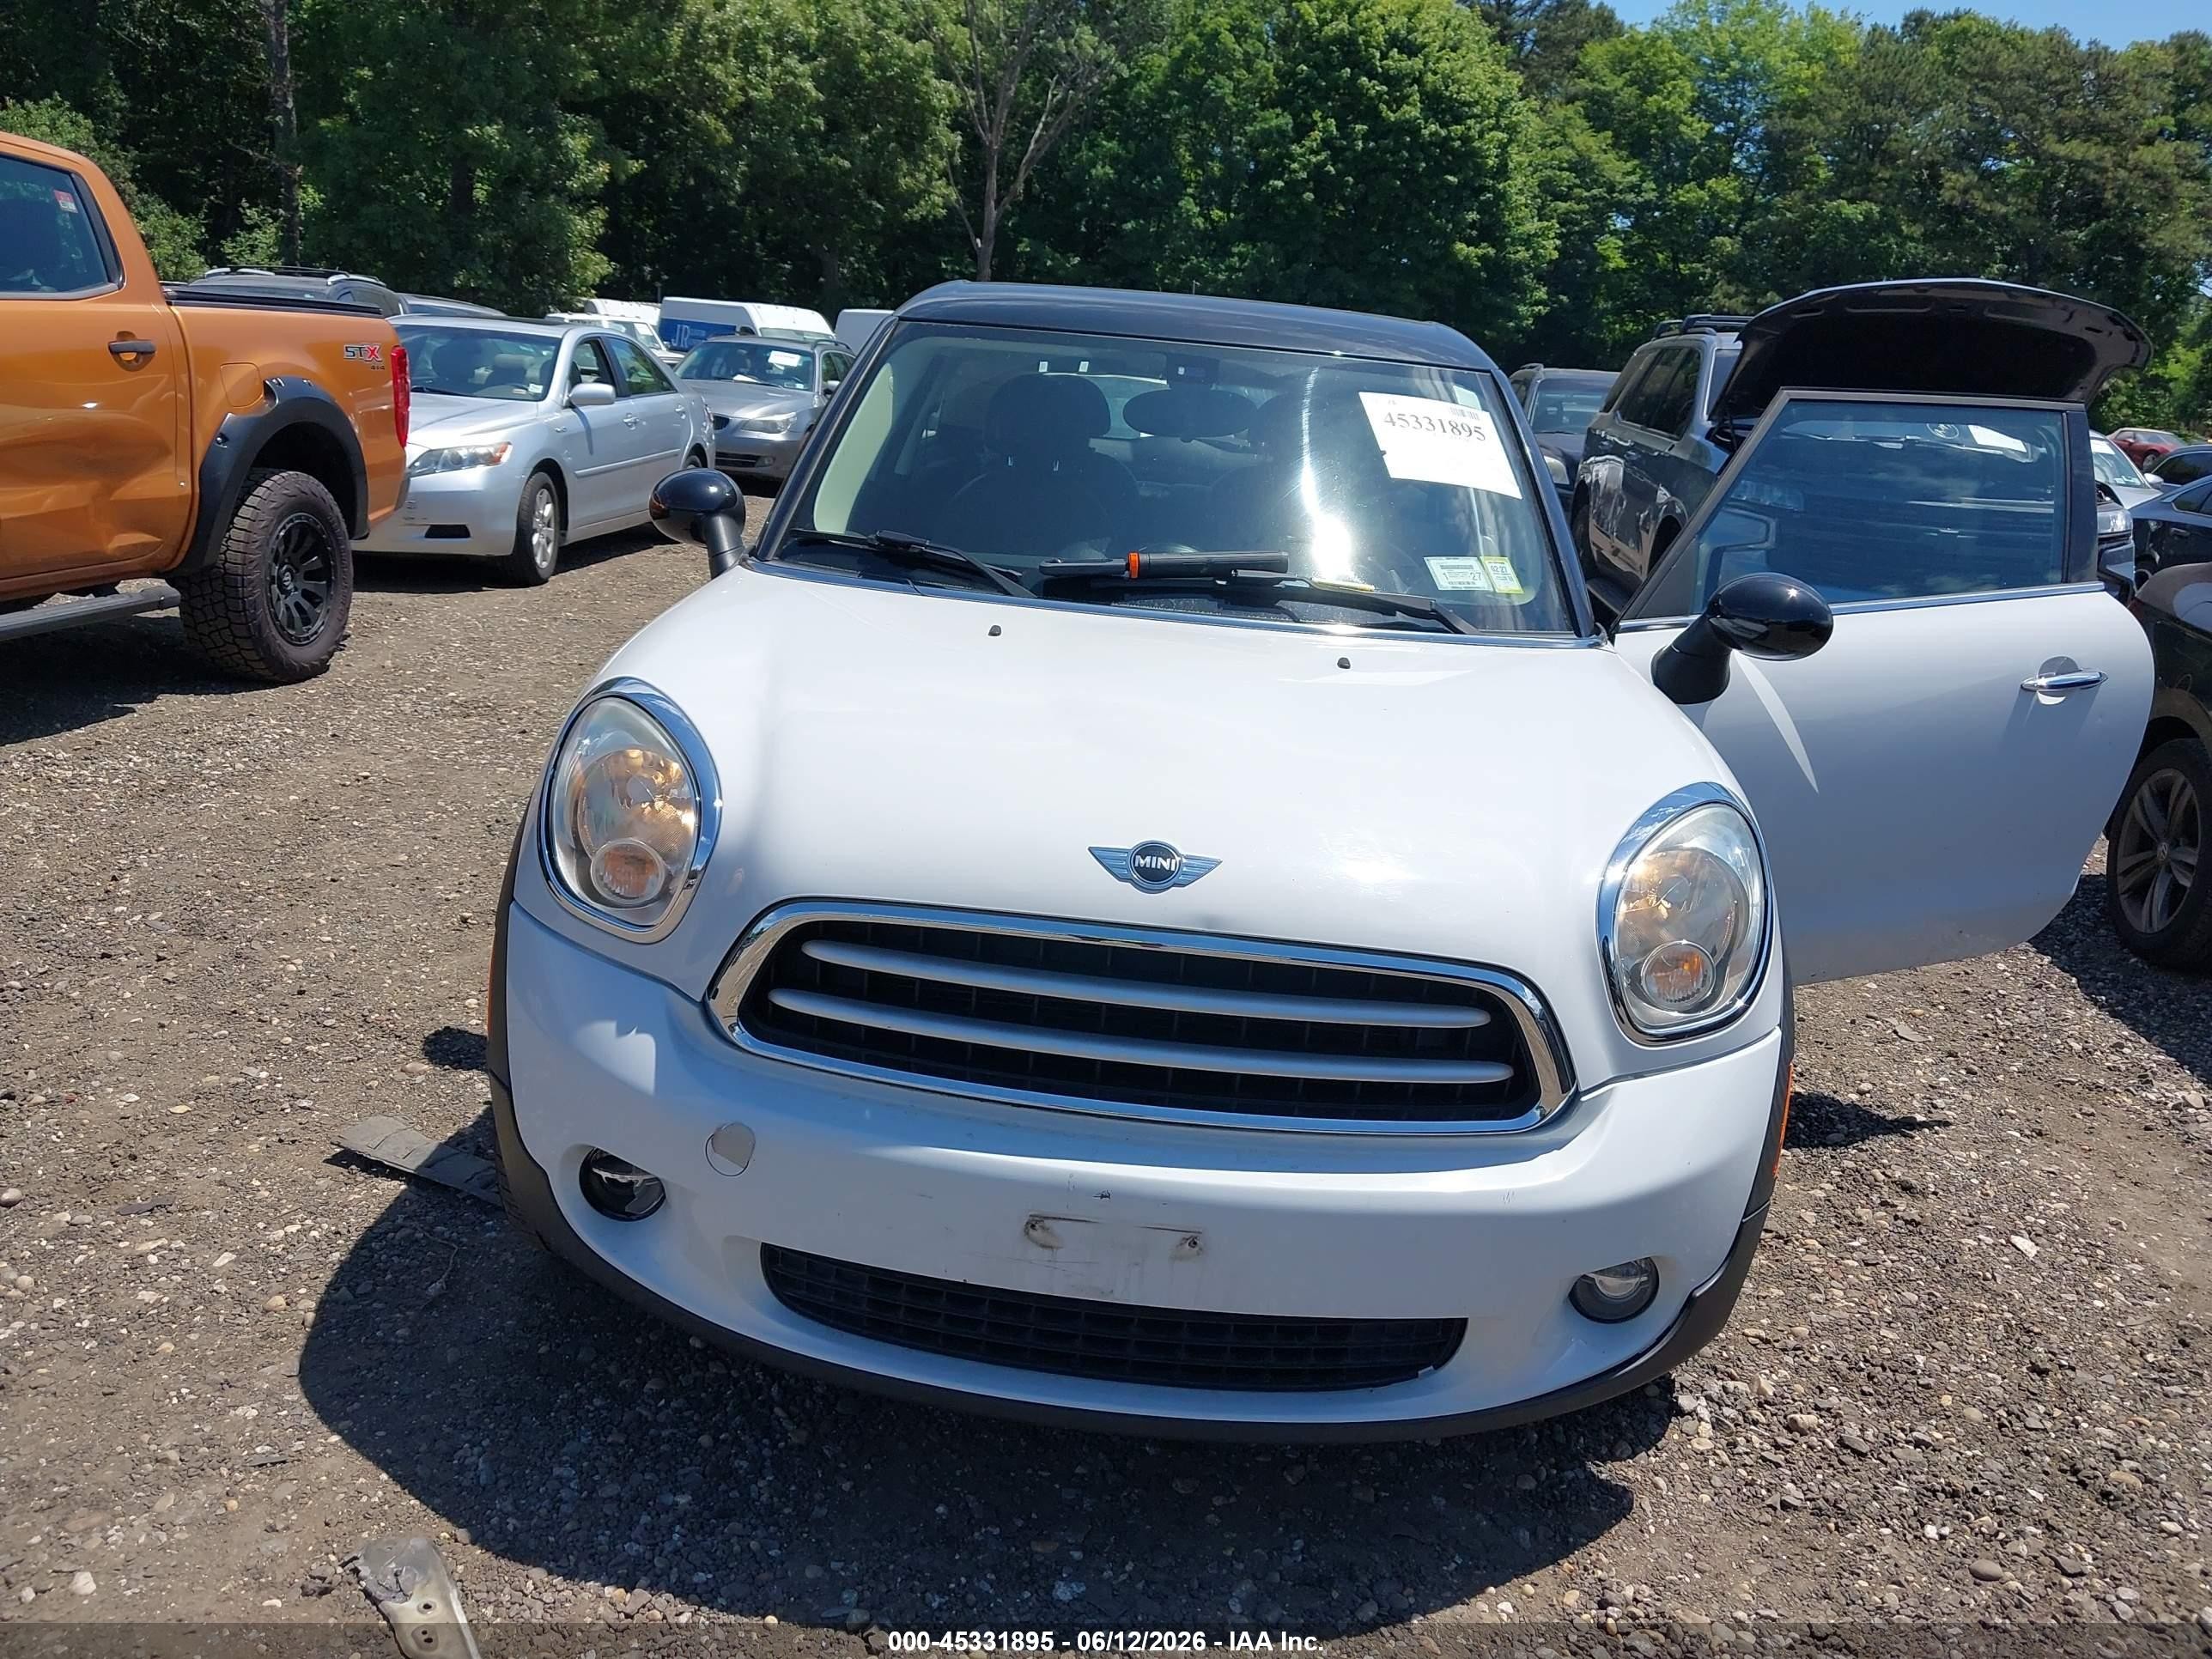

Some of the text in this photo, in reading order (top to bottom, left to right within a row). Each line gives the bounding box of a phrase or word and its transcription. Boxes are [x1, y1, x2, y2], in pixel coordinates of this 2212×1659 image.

[672, 324, 690, 348] JR
[343, 343, 383, 362] STX
[1383, 411, 1486, 441] 45331895
[1469, 572, 1481, 580] 27
[1134, 855, 1176, 871] MINI
